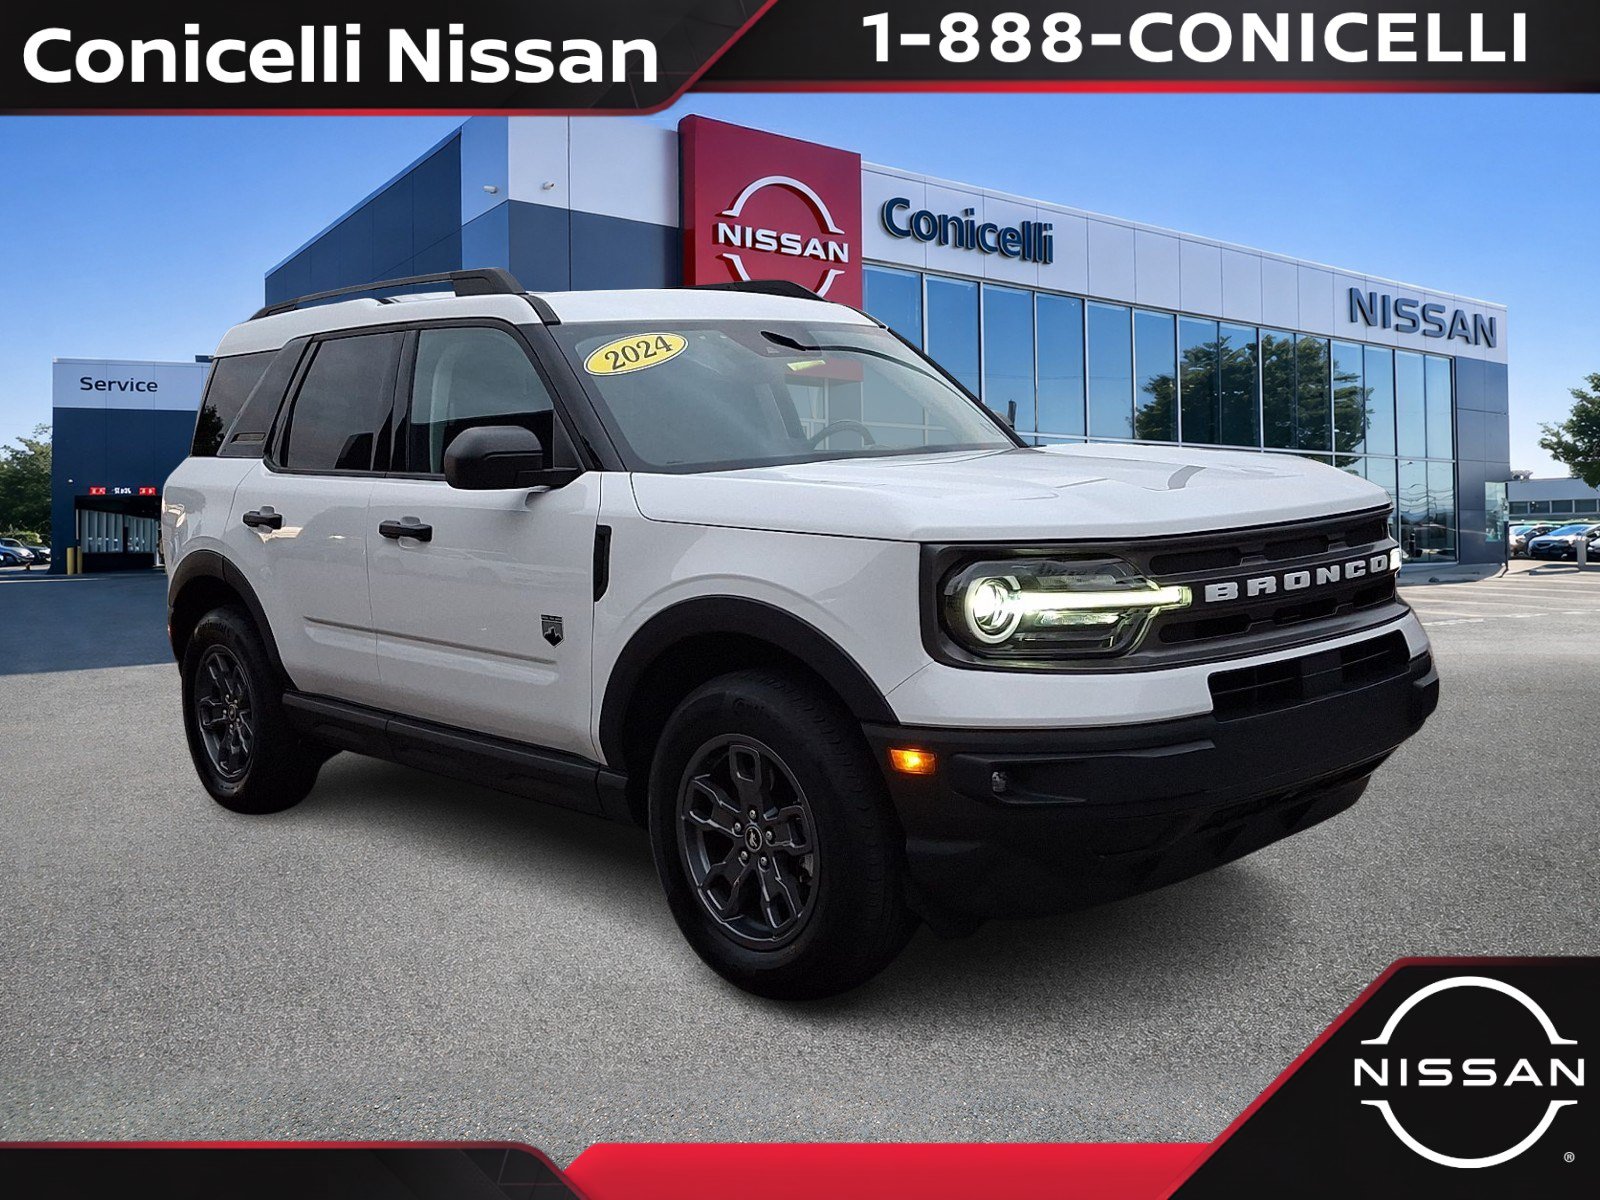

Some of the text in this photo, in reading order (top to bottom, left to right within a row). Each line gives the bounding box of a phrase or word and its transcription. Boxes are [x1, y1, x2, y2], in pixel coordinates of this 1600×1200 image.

[716, 223, 849, 263] NISSAN
[881, 197, 1053, 264] Conicelli
[1348, 287, 1497, 348] NISSAN
[604, 335, 673, 370] 2024
[80, 376, 158, 392] Service
[1205, 554, 1388, 602] BRONCO
